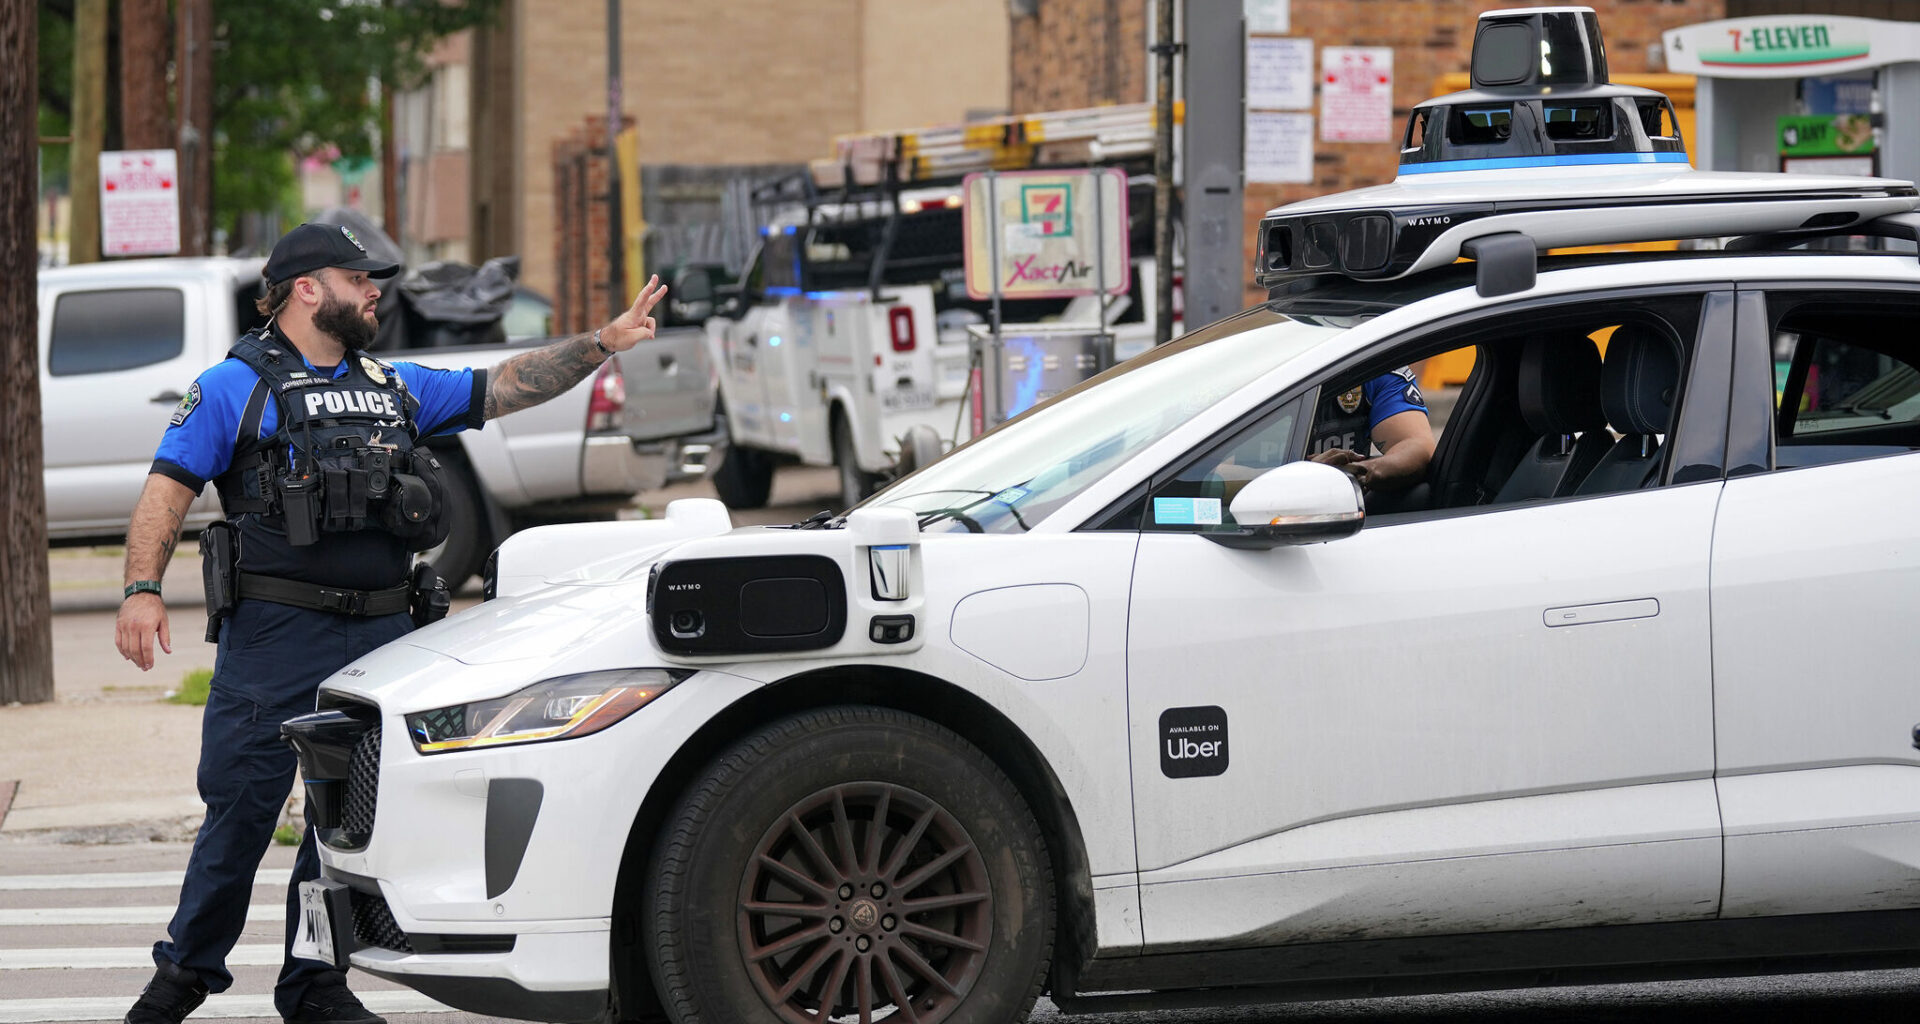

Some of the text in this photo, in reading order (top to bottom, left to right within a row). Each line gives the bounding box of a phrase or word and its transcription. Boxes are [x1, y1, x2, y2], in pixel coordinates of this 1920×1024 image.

[1407, 216, 1451, 227] WAYMO
[281, 378, 313, 390] JOHNSON
[304, 390, 398, 416] POLICE
[667, 583, 701, 591] WAYMO
[1169, 725, 1206, 734] AVAILABLE
[1167, 738, 1222, 760] Uber
